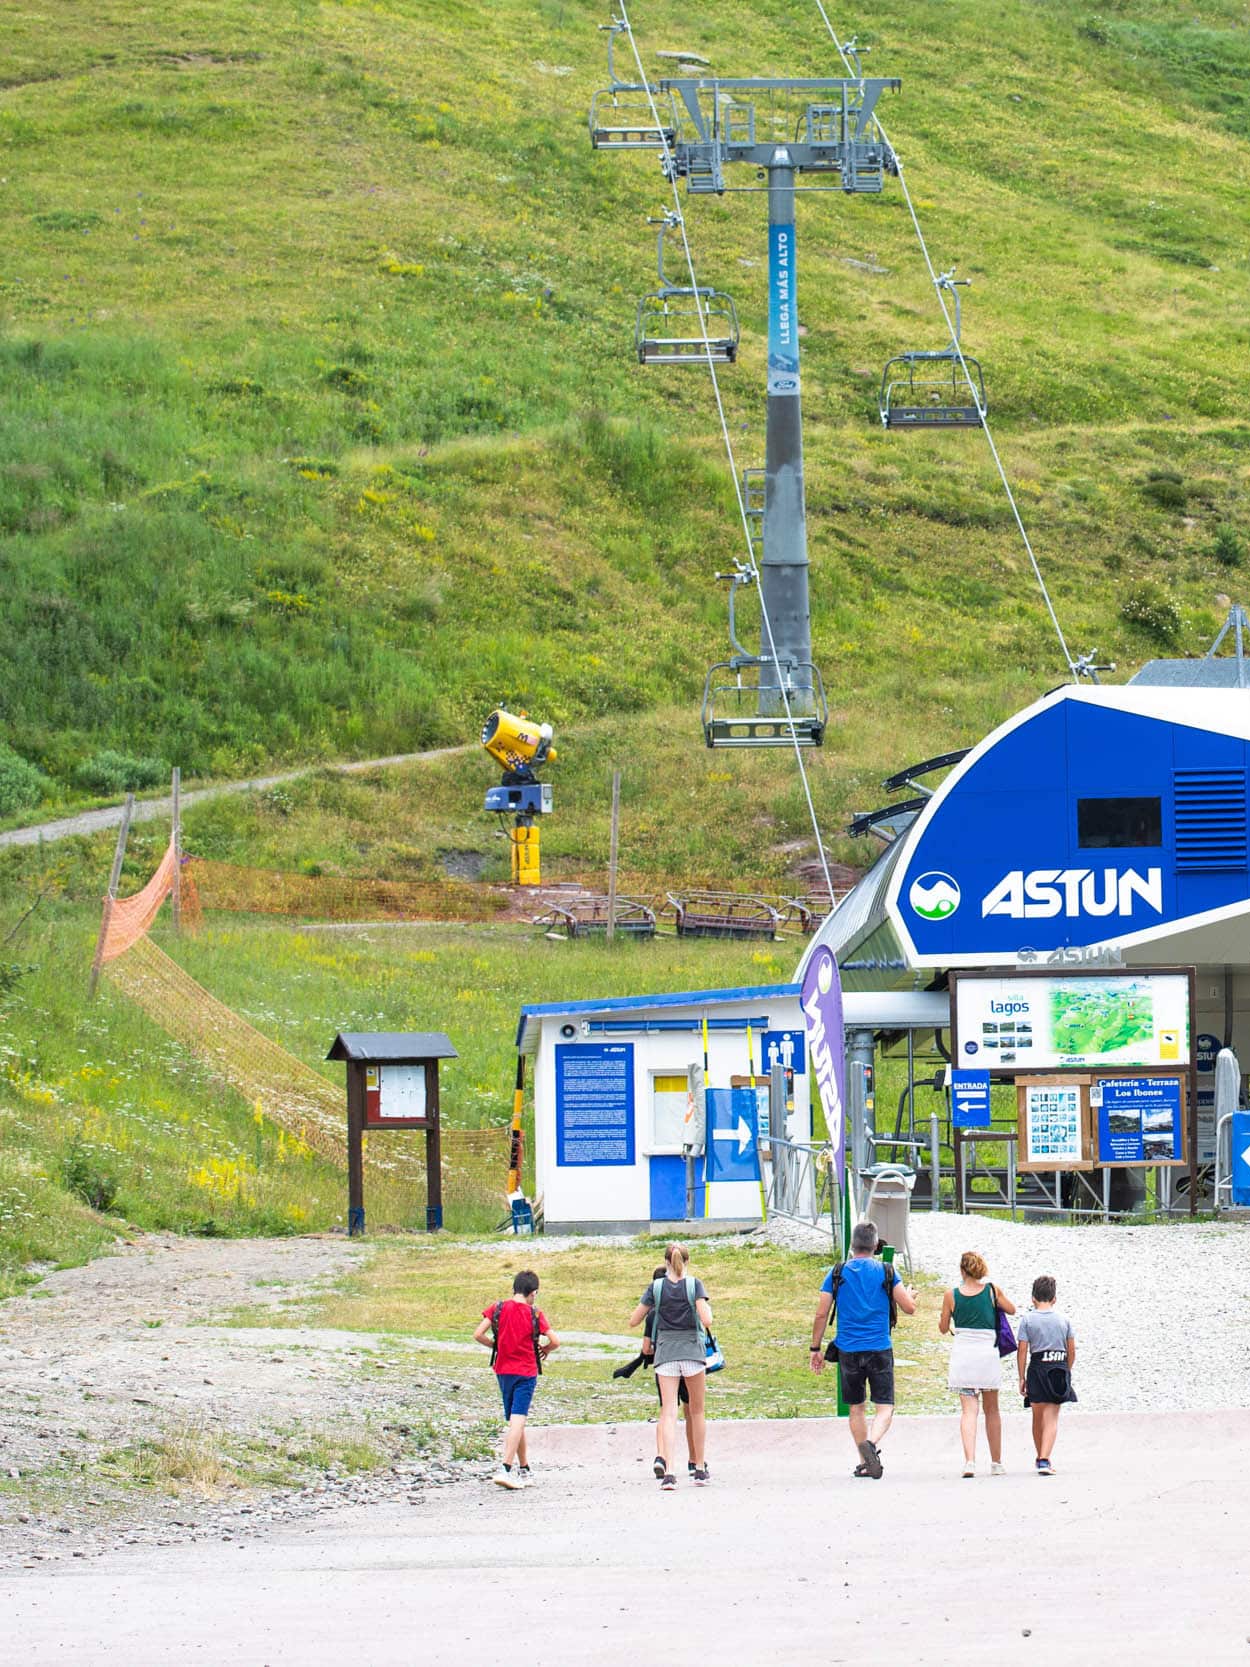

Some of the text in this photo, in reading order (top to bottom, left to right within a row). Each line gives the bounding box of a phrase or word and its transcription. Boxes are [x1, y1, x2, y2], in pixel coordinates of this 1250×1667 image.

[777, 232, 790, 345] LLEGA MÁS ALTO
[982, 867, 1162, 919] ASTUN
[1047, 946, 1121, 965] ASTUN
[990, 999, 1029, 1017] lagos
[1099, 1079, 1139, 1087] Cafetería
[1115, 1089, 1131, 1097] Los
